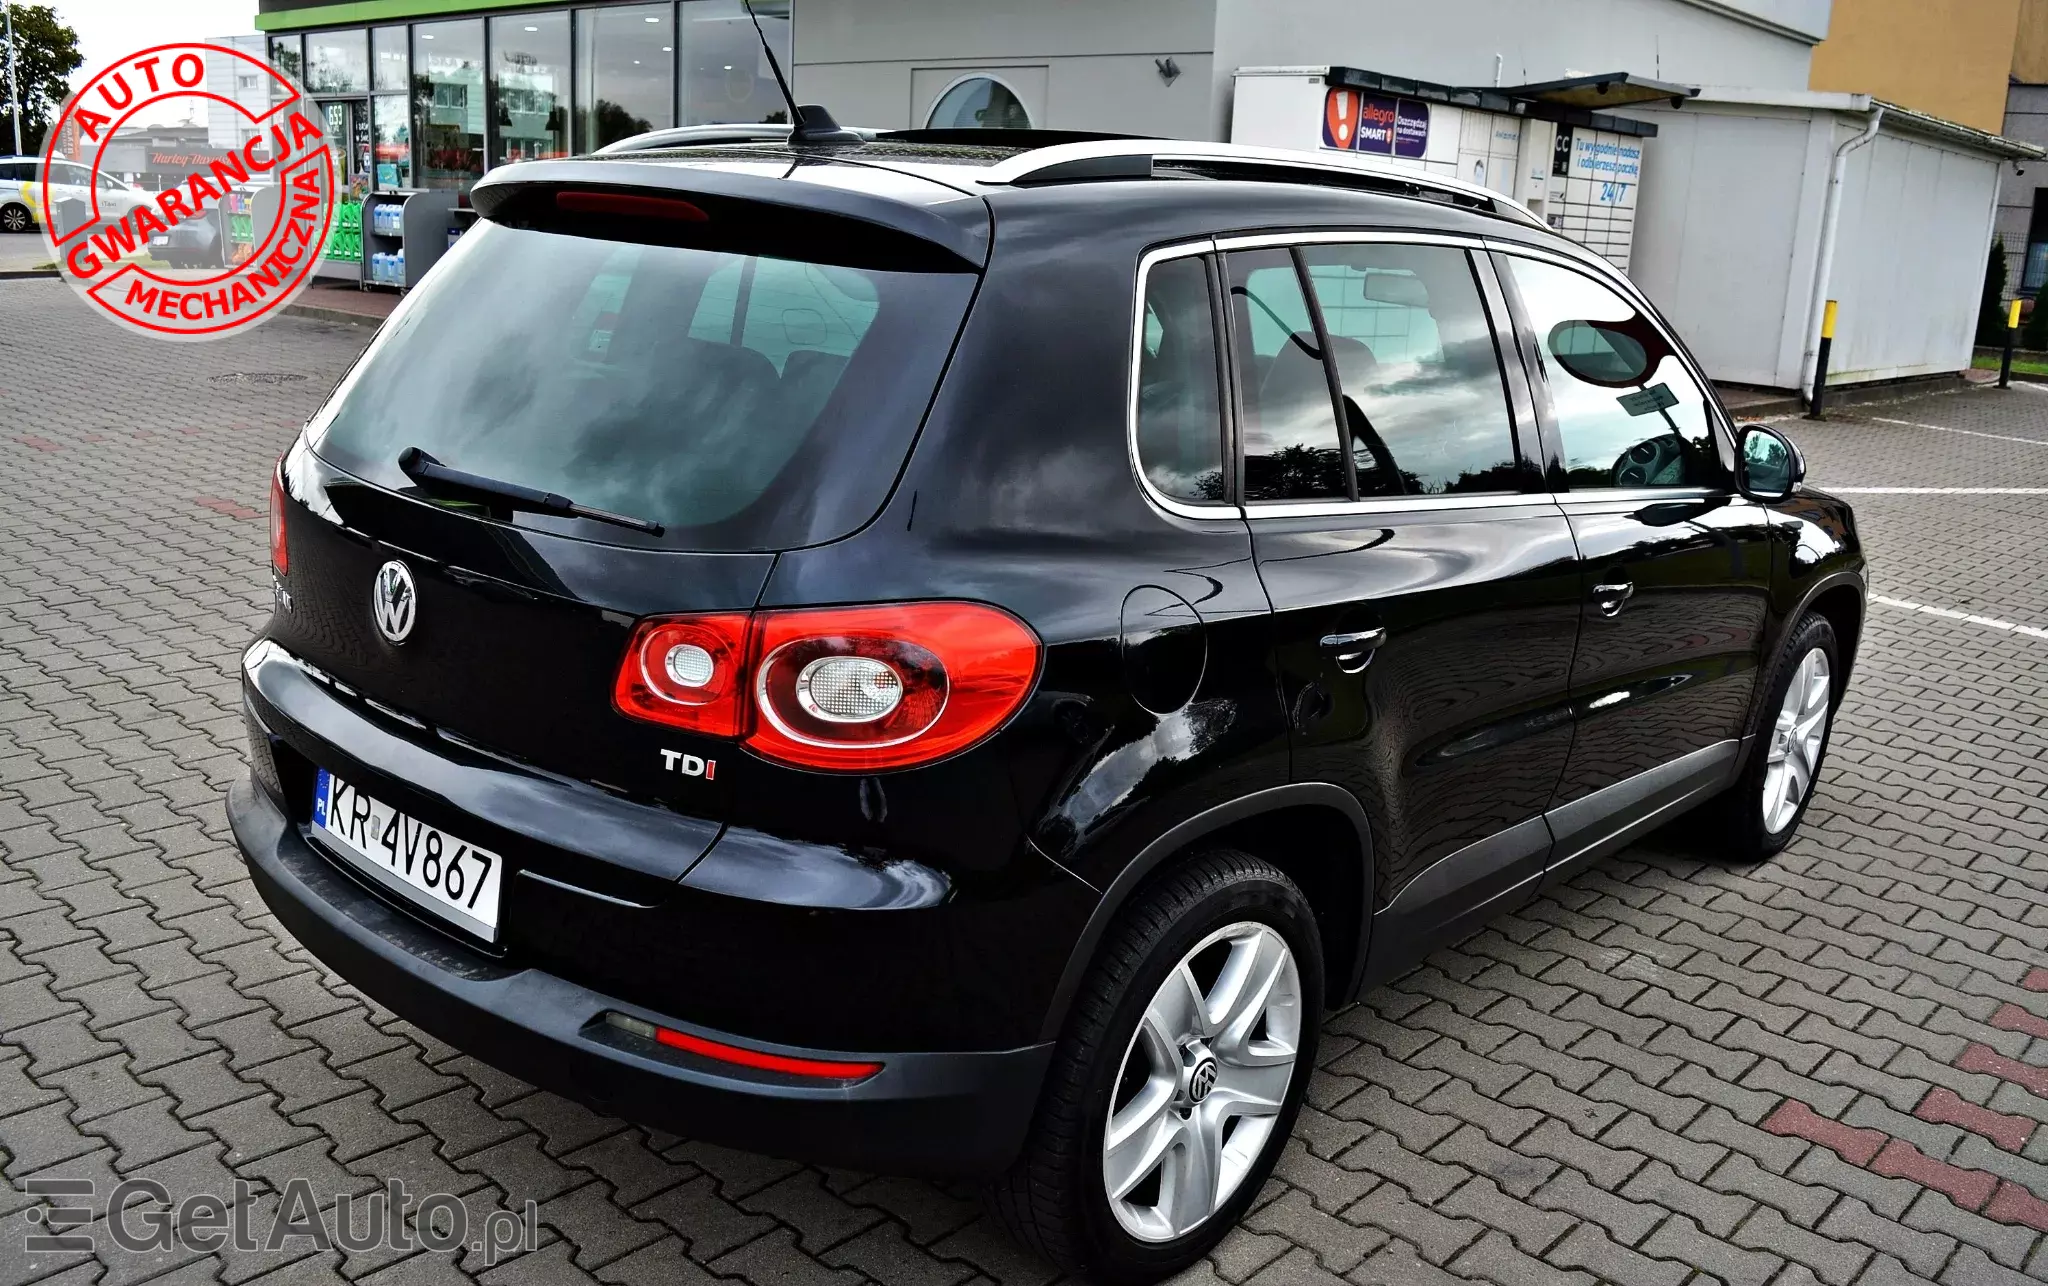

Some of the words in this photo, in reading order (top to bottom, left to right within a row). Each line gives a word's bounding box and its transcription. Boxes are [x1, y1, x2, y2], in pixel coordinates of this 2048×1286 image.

[1363, 104, 1395, 126] allegro
[1576, 138, 1585, 151] Tu
[1585, 142, 1618, 157] wygodnie
[1618, 145, 1640, 159] nadasz
[150, 152, 235, 167] Harley-Davids
[660, 748, 717, 780] TDI
[316, 798, 326, 816] PL
[329, 775, 372, 850] KR
[381, 809, 493, 910] 4V867
